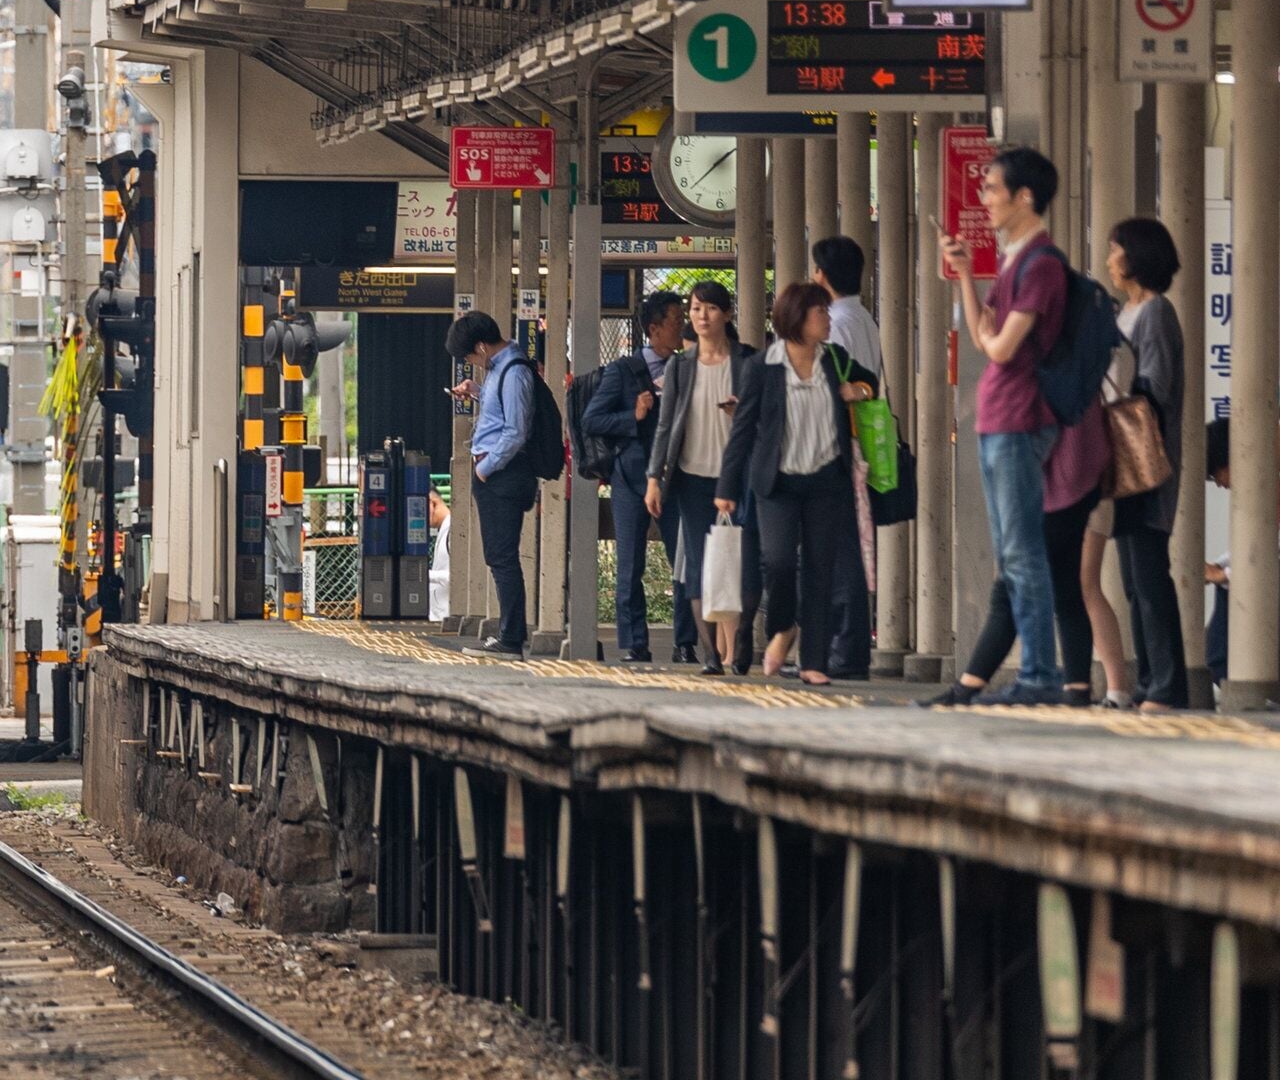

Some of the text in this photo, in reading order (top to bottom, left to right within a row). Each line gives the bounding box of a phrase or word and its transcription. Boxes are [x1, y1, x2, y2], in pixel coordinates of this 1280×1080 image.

[784, 3, 846, 26] 13:38
[703, 26, 729, 70] 1
[797, 66, 969, 91] 当駅 十三
[460, 149, 489, 160] SOS
[674, 156, 682, 167] 9
[680, 177, 688, 188] 8
[695, 193, 702, 204] 7
[715, 198, 724, 209] 6
[623, 203, 659, 221] 当駅
[404, 227, 420, 236] TEL
[404, 239, 456, 252] 改札出て
[339, 271, 418, 286] きた西出口
[338, 288, 408, 297] North West Gates
[372, 476, 382, 487] 4
